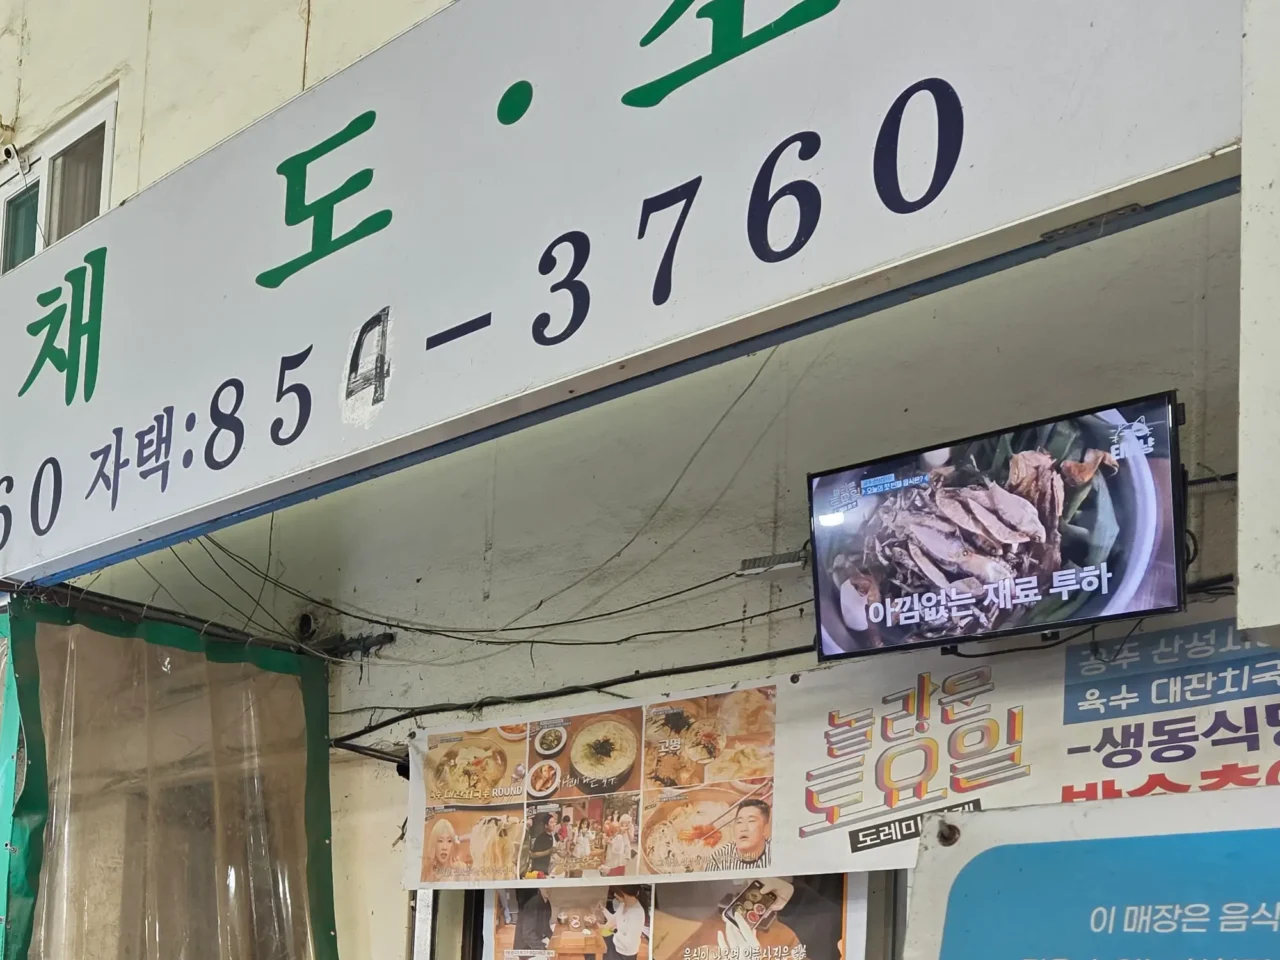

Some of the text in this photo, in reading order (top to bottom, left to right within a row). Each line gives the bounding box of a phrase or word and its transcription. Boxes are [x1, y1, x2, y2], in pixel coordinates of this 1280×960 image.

[868, 561, 1113, 628] 아낌없는 재료 투하
[1077, 684, 1140, 714] 육수
[658, 738, 682, 753] 고명
[492, 786, 523, 798] ROUND
[856, 816, 921, 850] 도레미
[1090, 905, 1116, 934] 이
[1123, 903, 1211, 934] 매장은
